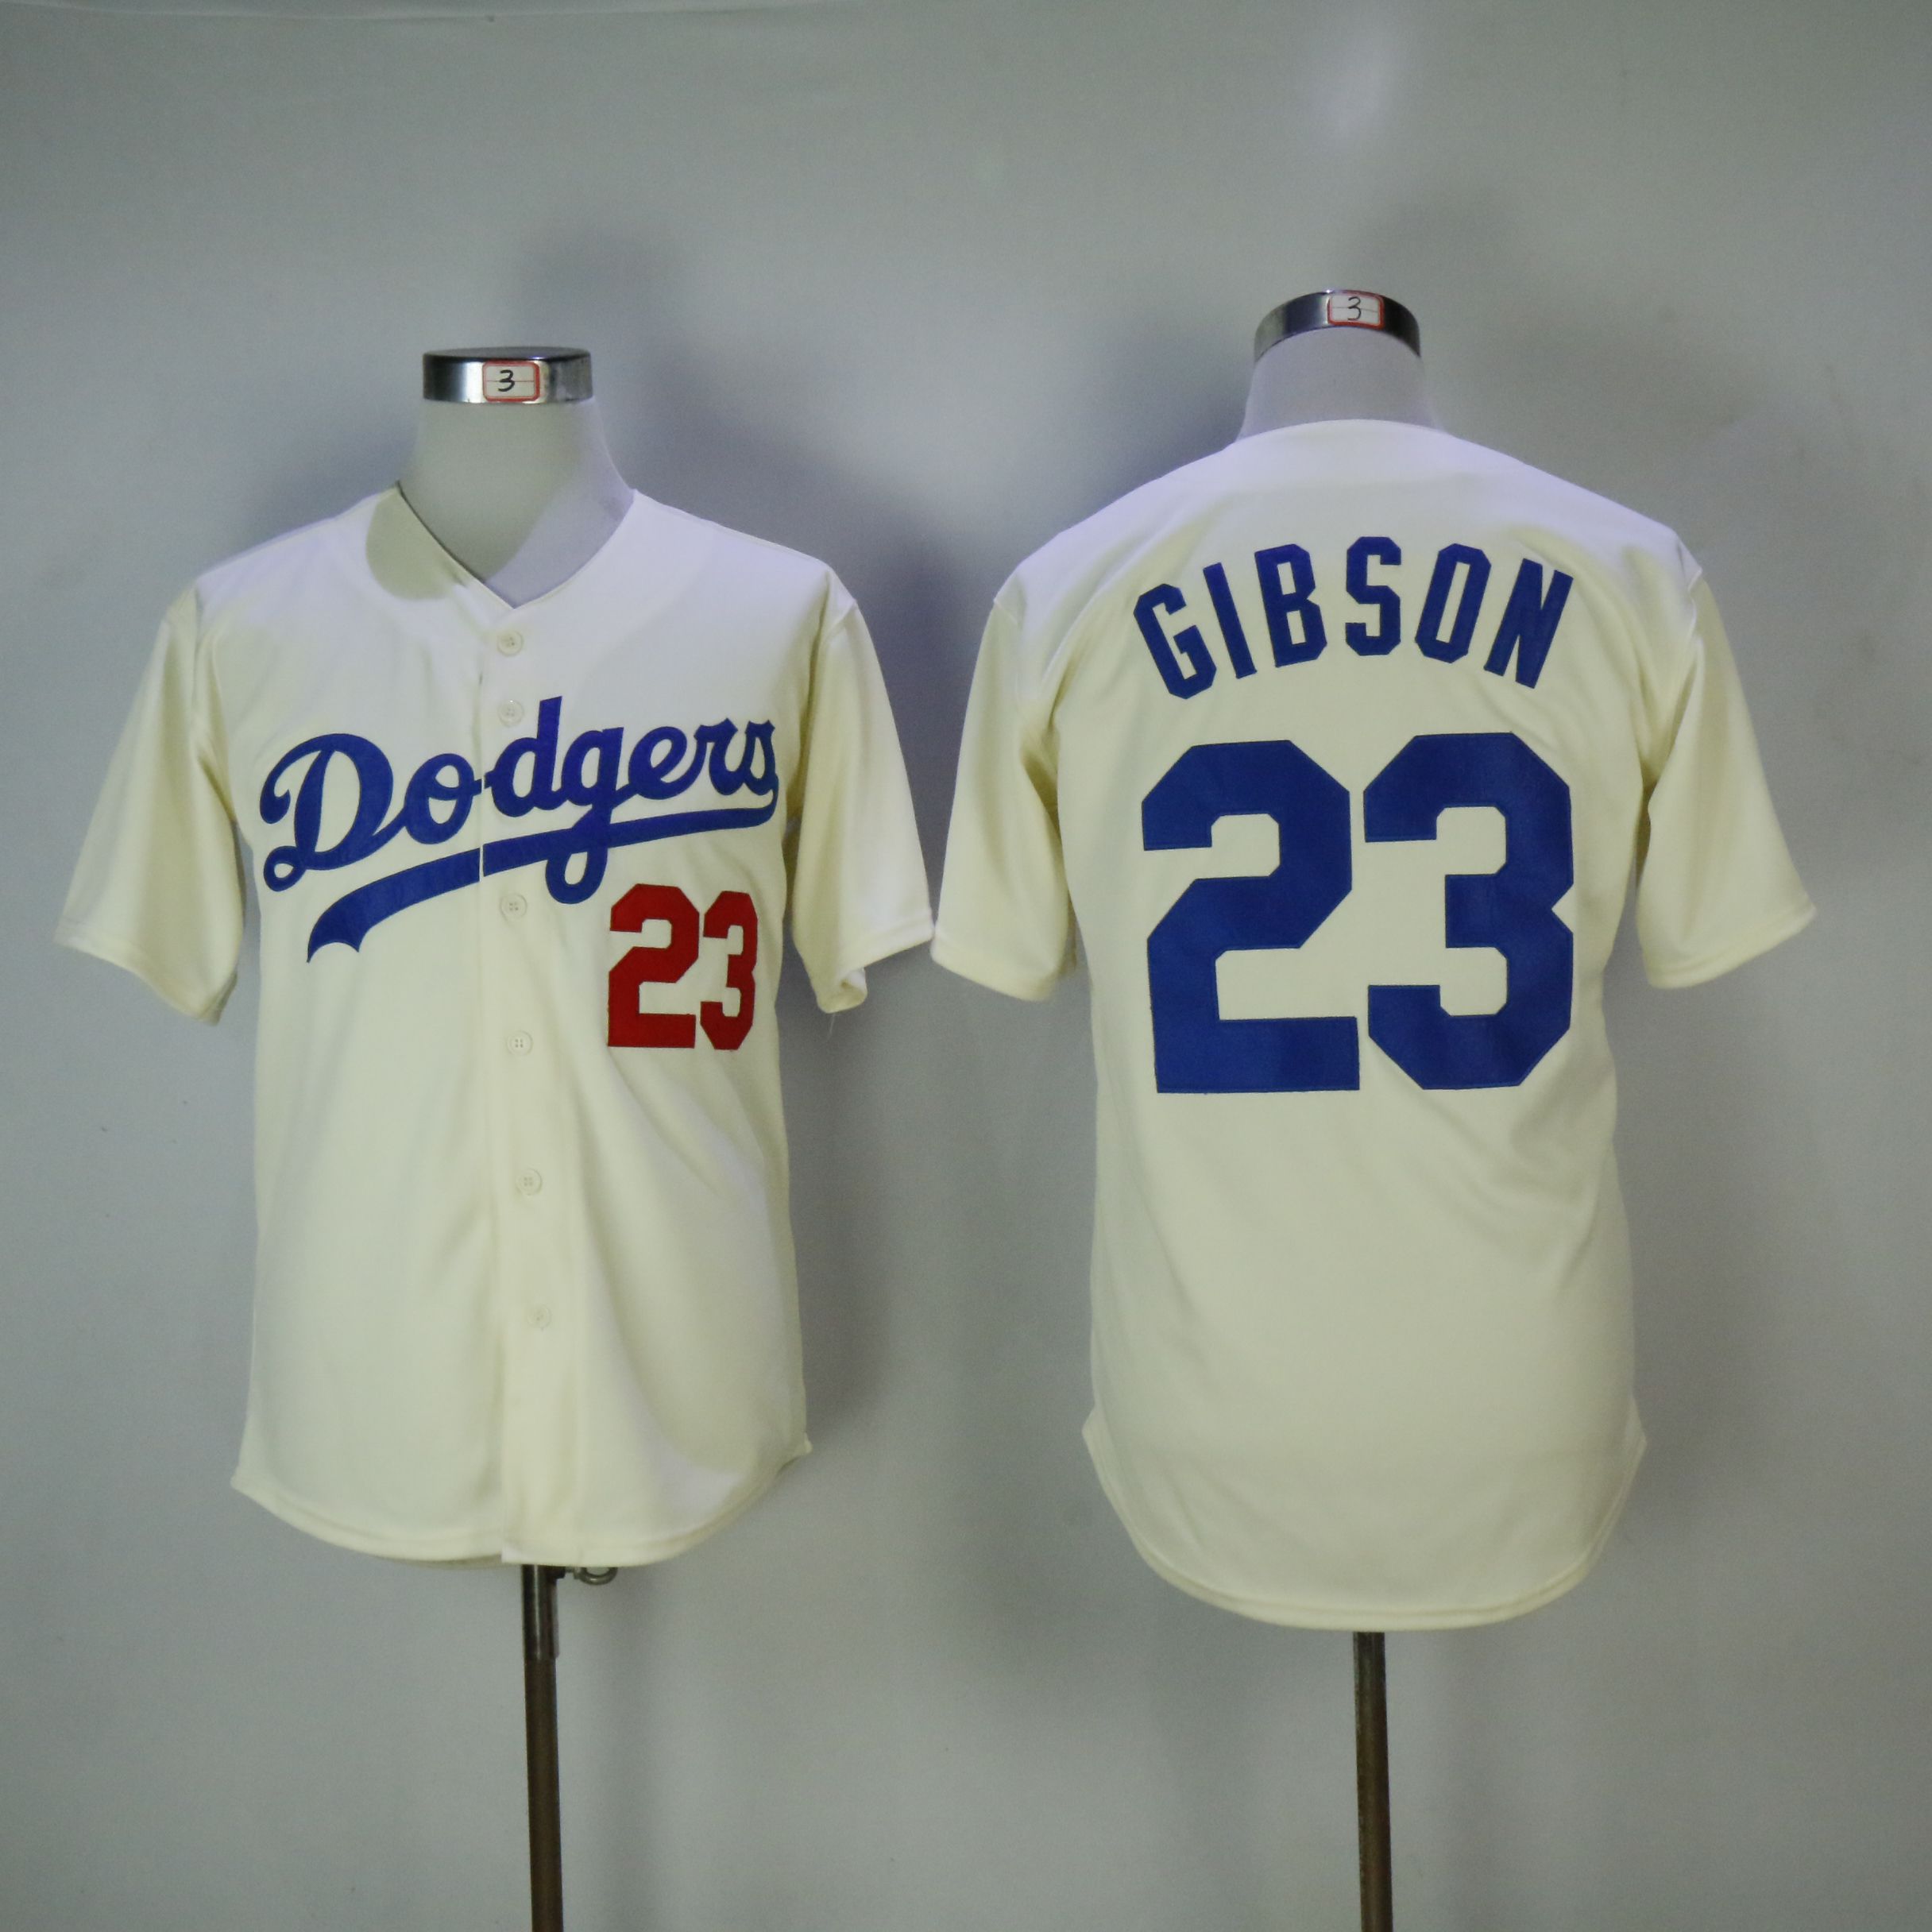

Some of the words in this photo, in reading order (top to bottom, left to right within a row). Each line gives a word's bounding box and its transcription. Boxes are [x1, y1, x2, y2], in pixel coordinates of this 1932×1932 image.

[498, 369, 515, 392] 3
[1347, 296, 1362, 320] 3
[1134, 536, 1573, 699] GIBSON
[261, 696, 778, 904] Dodgers
[608, 883, 757, 1049] 23
[1142, 732, 1573, 1094] 23
